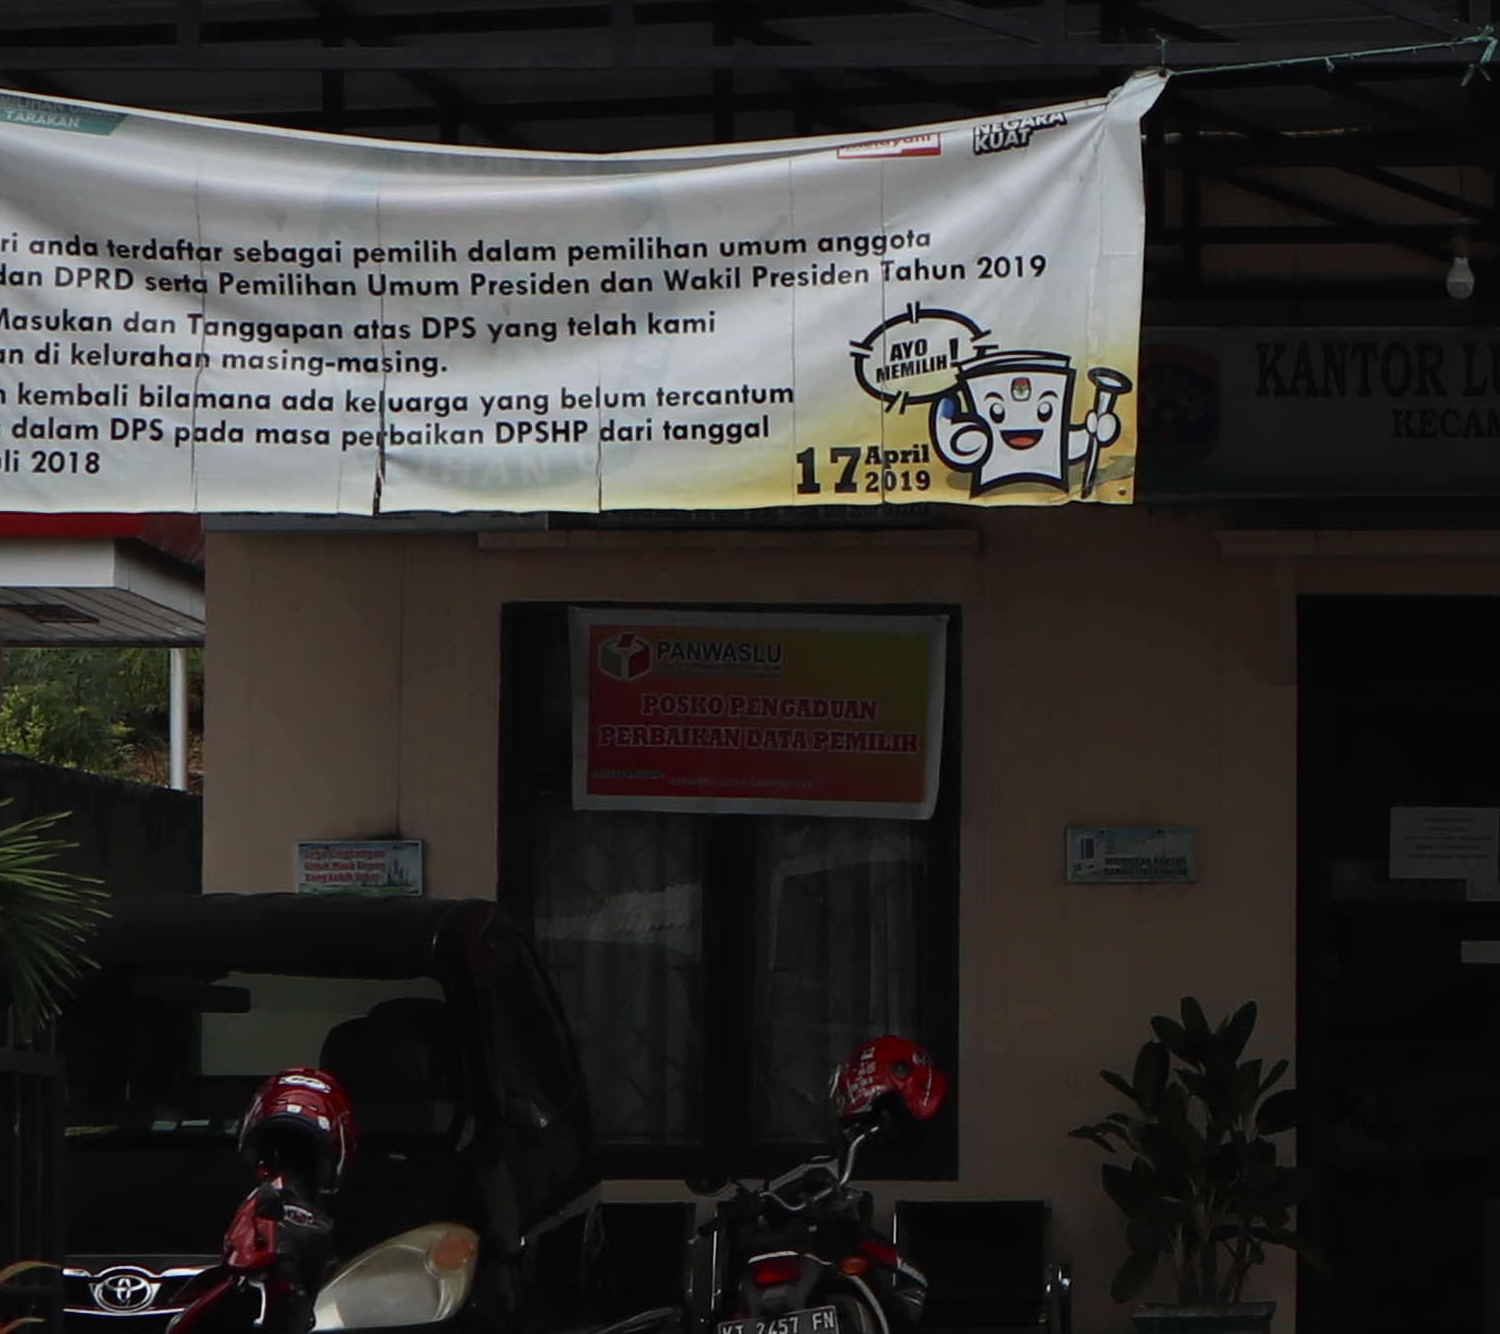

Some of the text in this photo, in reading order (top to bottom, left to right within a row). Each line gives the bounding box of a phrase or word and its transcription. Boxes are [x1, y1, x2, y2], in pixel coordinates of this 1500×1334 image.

[974, 129, 1031, 153] KUAT
[30, 233, 99, 258] anda
[107, 236, 223, 264] terdaftar
[233, 239, 342, 270] sebagai
[353, 240, 457, 271] pemilih
[467, 240, 556, 263] dalam
[567, 236, 708, 266] pemilihan
[719, 235, 807, 258] umum
[817, 228, 931, 258] anggota
[54, 265, 134, 291] DPRD
[145, 270, 207, 295] serta
[219, 271, 358, 298] Pemilihan
[367, 272, 459, 298] Umum
[471, 272, 590, 296] Presiden
[600, 266, 653, 292] dan
[664, 264, 741, 292] Wakil
[752, 261, 870, 288] Presiden
[881, 258, 966, 283] Tahun
[976, 255, 1047, 281] 2019
[123, 310, 177, 335] dan
[187, 312, 343, 344] Tanggapan
[353, 315, 411, 341] atas
[422, 317, 476, 340] DPS
[487, 320, 557, 344] yang
[567, 314, 637, 338] telah
[647, 311, 716, 336] kami
[890, 338, 927, 361] AYO
[1254, 341, 1446, 398] KANTOR
[864, 444, 930, 469] April
[796, 447, 861, 494] 17
[865, 470, 931, 493] 2019
[657, 640, 782, 664] PANWASLU
[641, 694, 877, 719] POSKO PENGADUAN
[600, 725, 918, 753] PERBAIKAN DATA PEMILIH
[812, 1311, 834, 1332] FN
